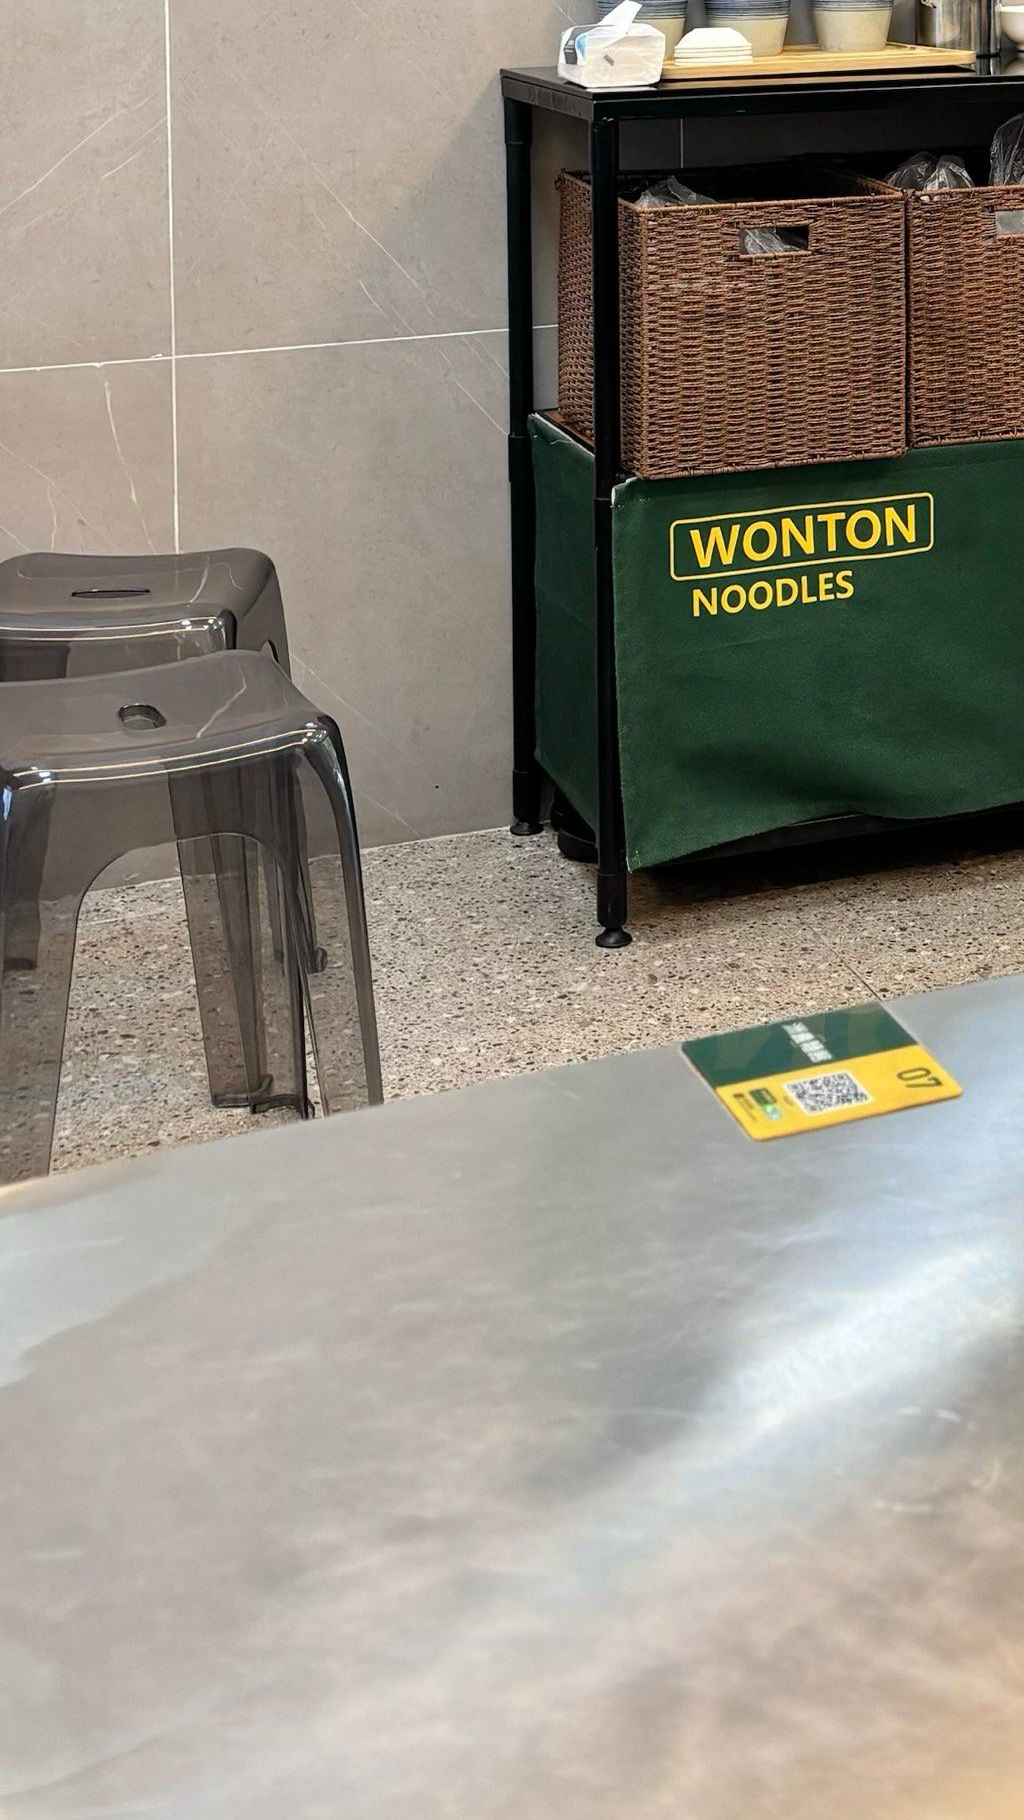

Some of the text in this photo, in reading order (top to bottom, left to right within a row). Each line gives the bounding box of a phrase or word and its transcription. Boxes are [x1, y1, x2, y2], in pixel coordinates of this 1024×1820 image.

[689, 504, 916, 568] WONTON
[692, 570, 854, 617] NOODLES
[896, 1066, 943, 1089] 07
